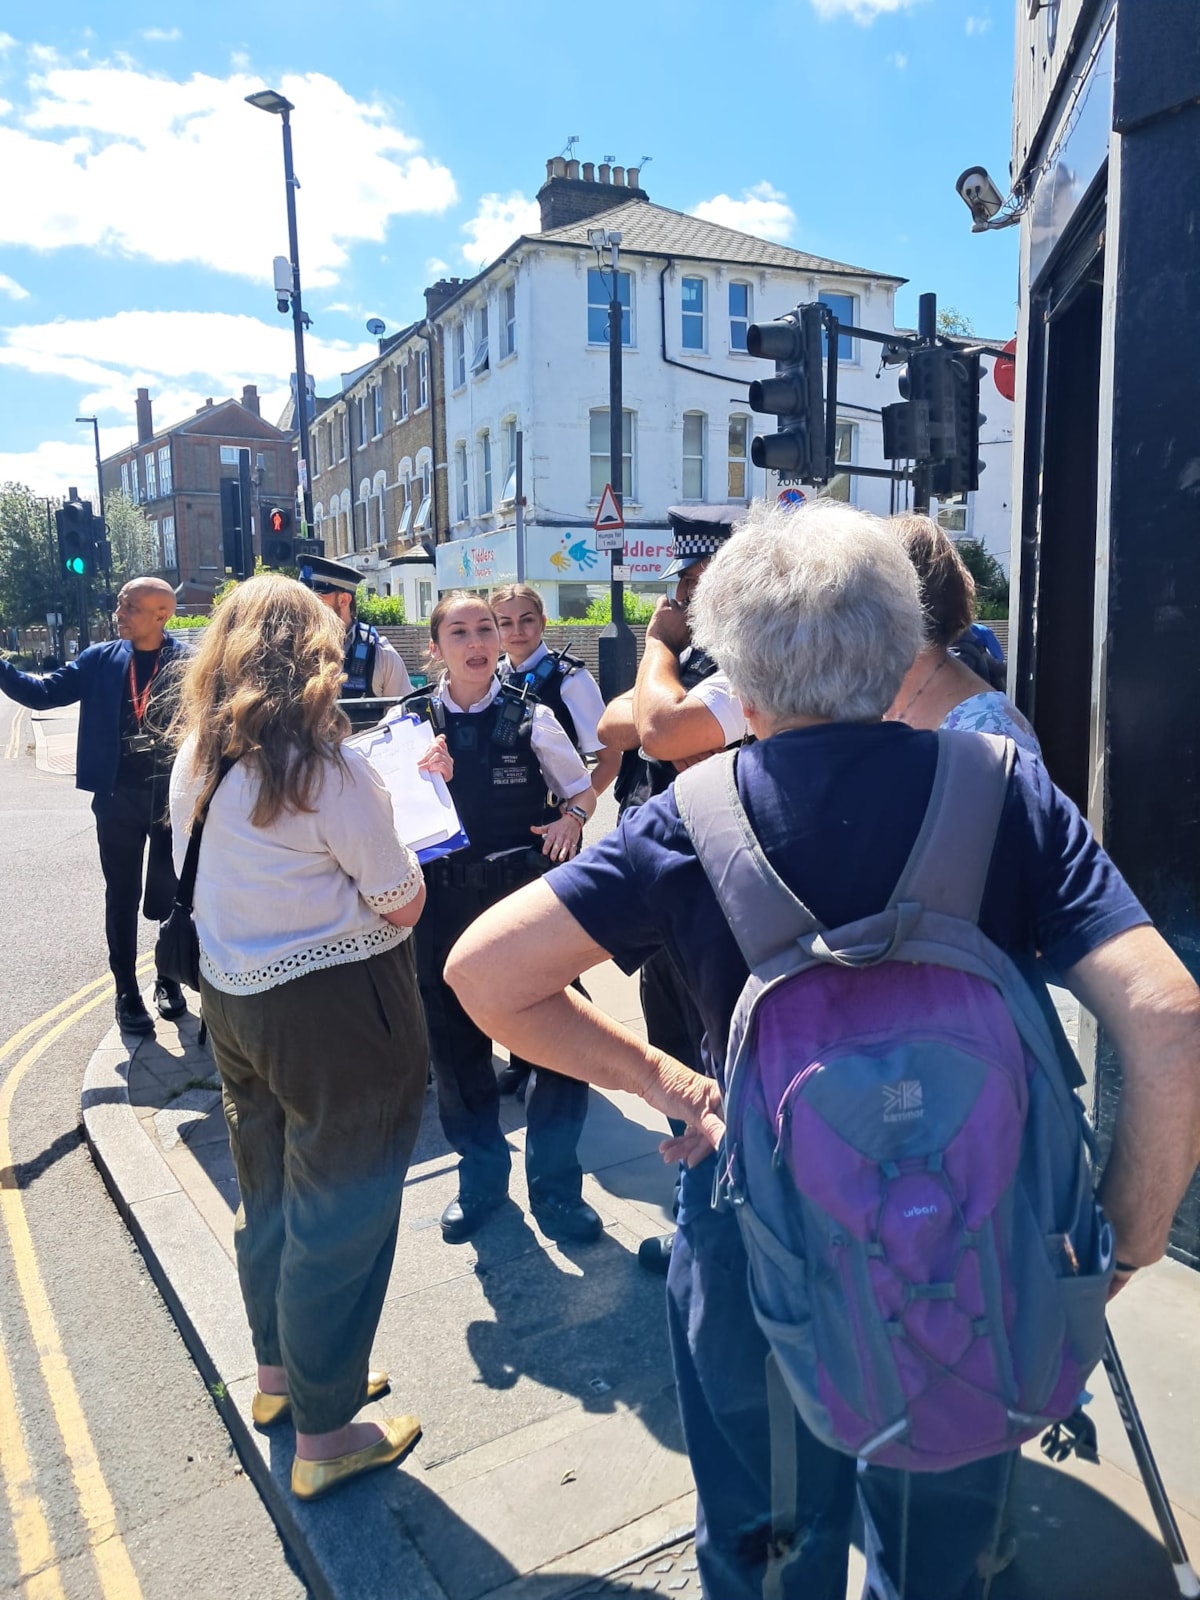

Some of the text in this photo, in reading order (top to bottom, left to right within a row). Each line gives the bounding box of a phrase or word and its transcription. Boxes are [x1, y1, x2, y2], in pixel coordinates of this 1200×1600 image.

[777, 478, 800, 486] ZON
[605, 540, 674, 557] ddlers
[903, 1204, 937, 1217] urban
